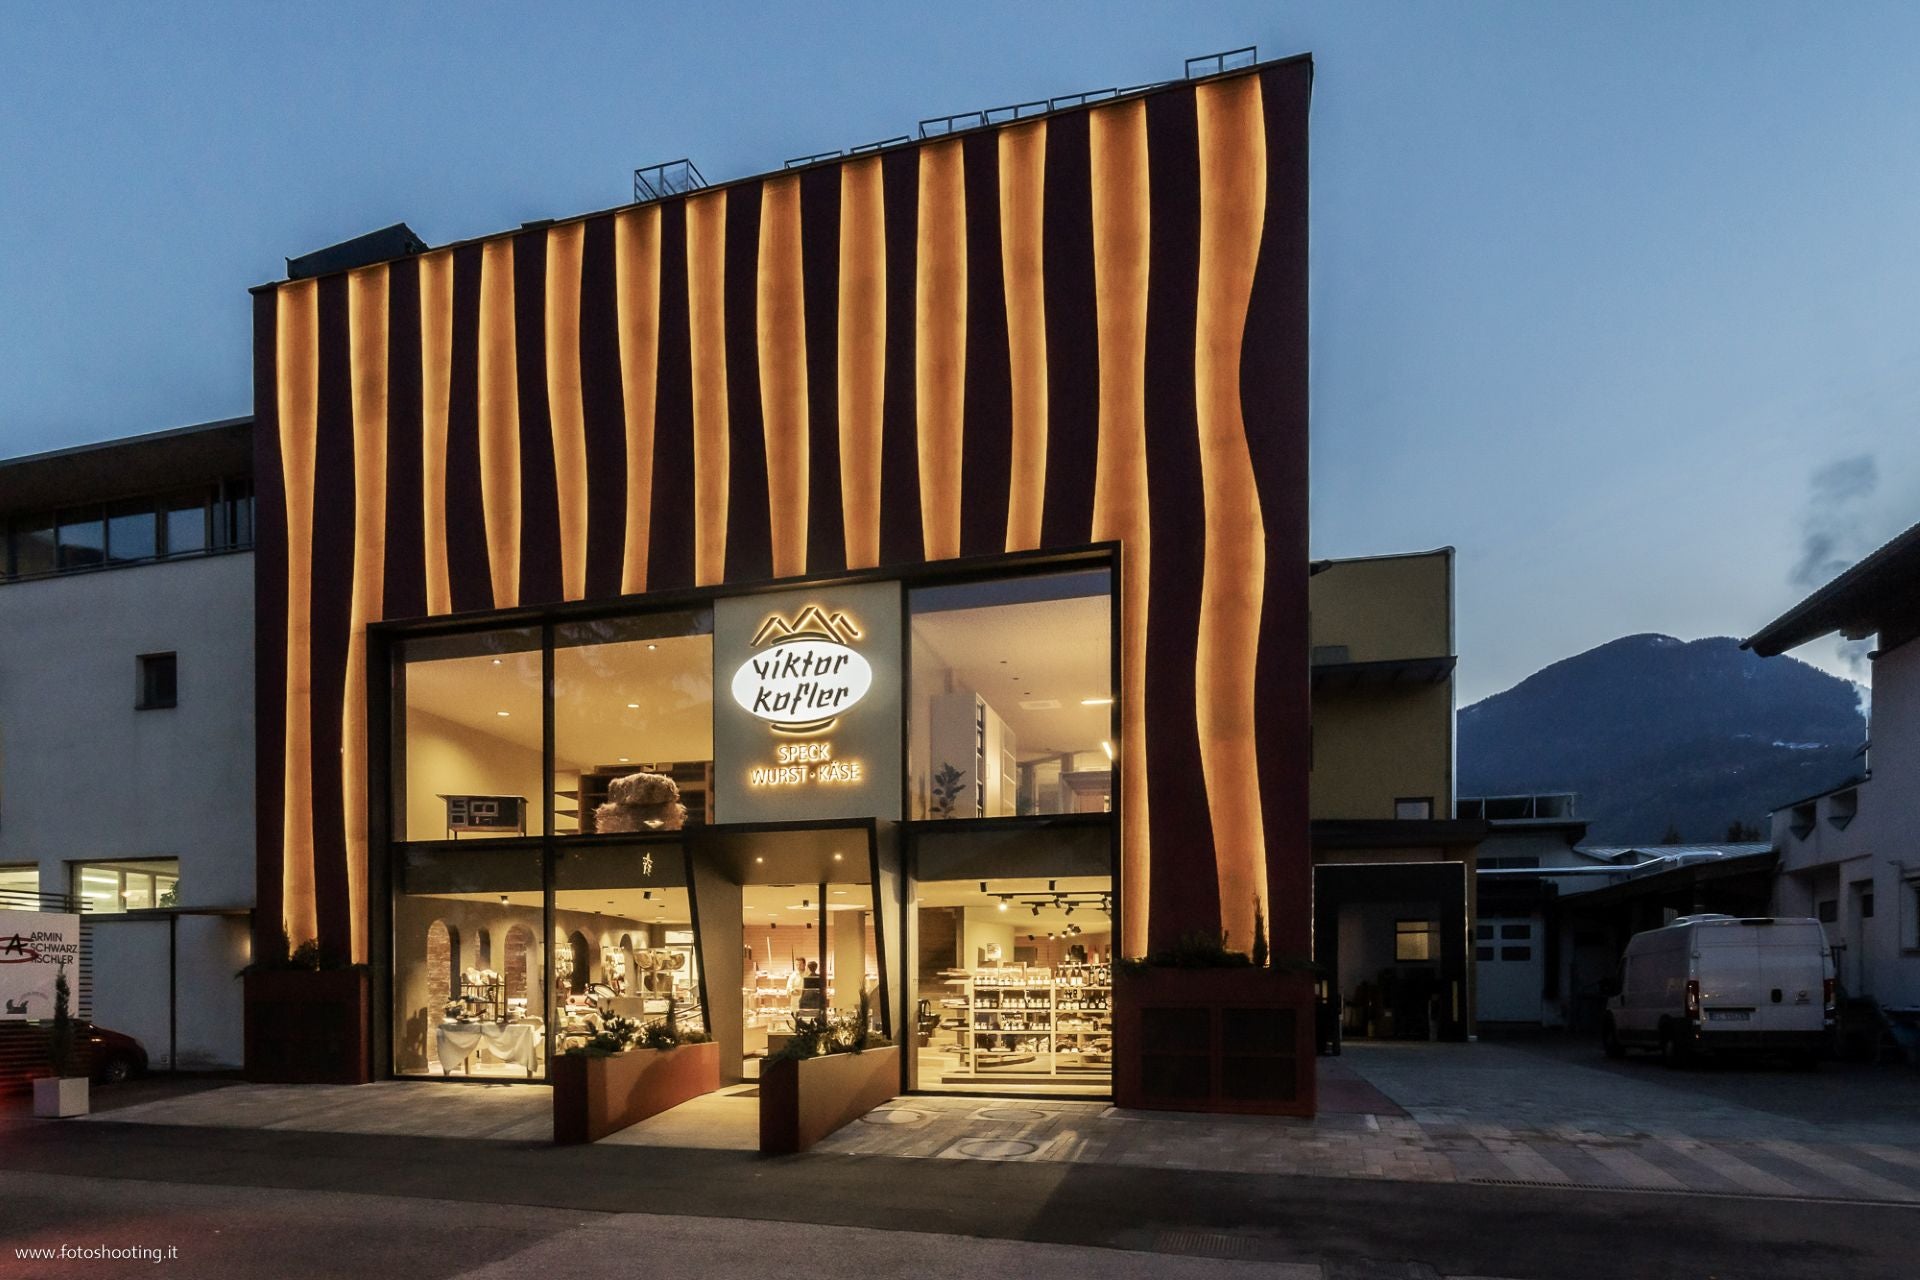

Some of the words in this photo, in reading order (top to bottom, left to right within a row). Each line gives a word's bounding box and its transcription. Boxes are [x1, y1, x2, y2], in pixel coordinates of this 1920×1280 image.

[778, 743, 830, 763] SPECK
[751, 766, 809, 785] WURST
[818, 761, 861, 782] KÄSE
[30, 932, 62, 942] ARMIN
[30, 943, 77, 953] SCHWARZ
[31, 954, 74, 965] ISCHLER
